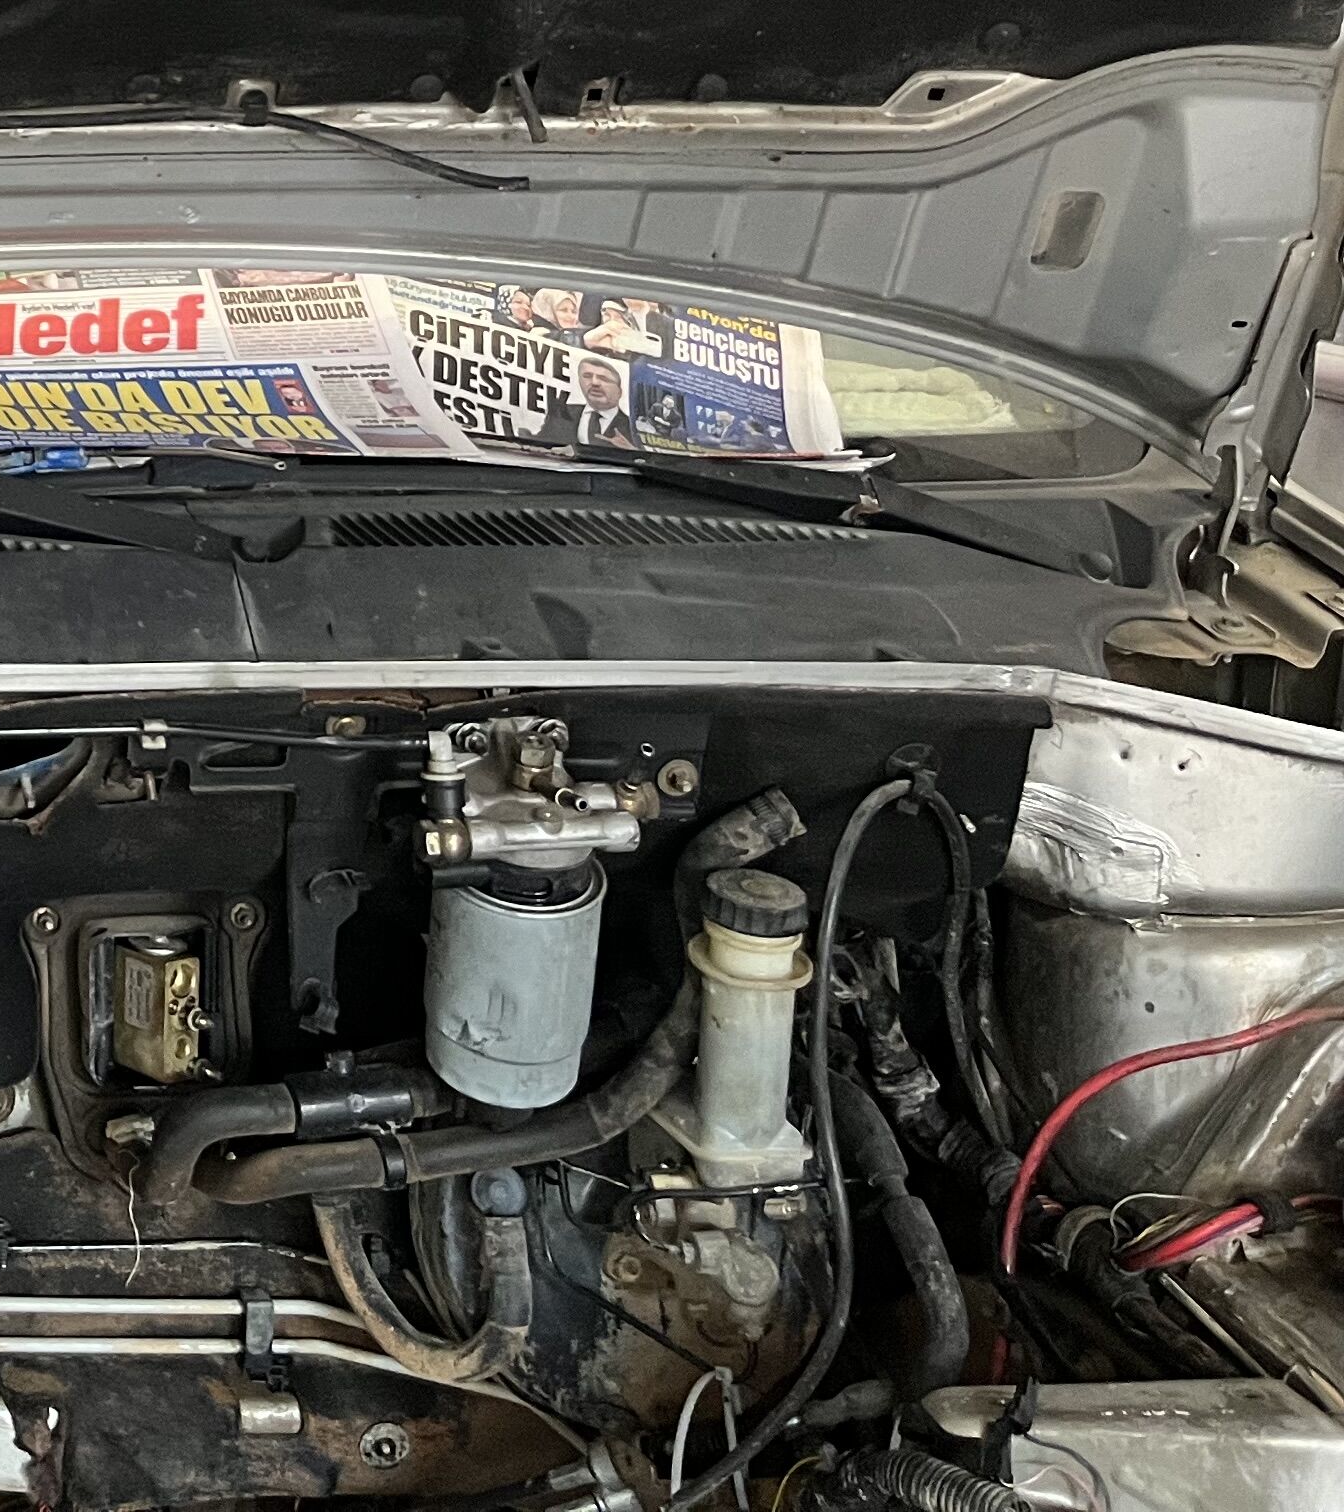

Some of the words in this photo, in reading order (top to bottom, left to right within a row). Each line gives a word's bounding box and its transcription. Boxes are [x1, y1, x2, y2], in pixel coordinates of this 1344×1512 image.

[219, 289, 286, 305] BAYRAMDA
[224, 303, 294, 325] KONUĞU
[295, 301, 369, 322] OLDULAR
[410, 310, 570, 383] ÇİFTÇİYE
[674, 318, 779, 365] gençlerle
[673, 338, 781, 390] BULUŞTU
[159, 378, 272, 415] DEV
